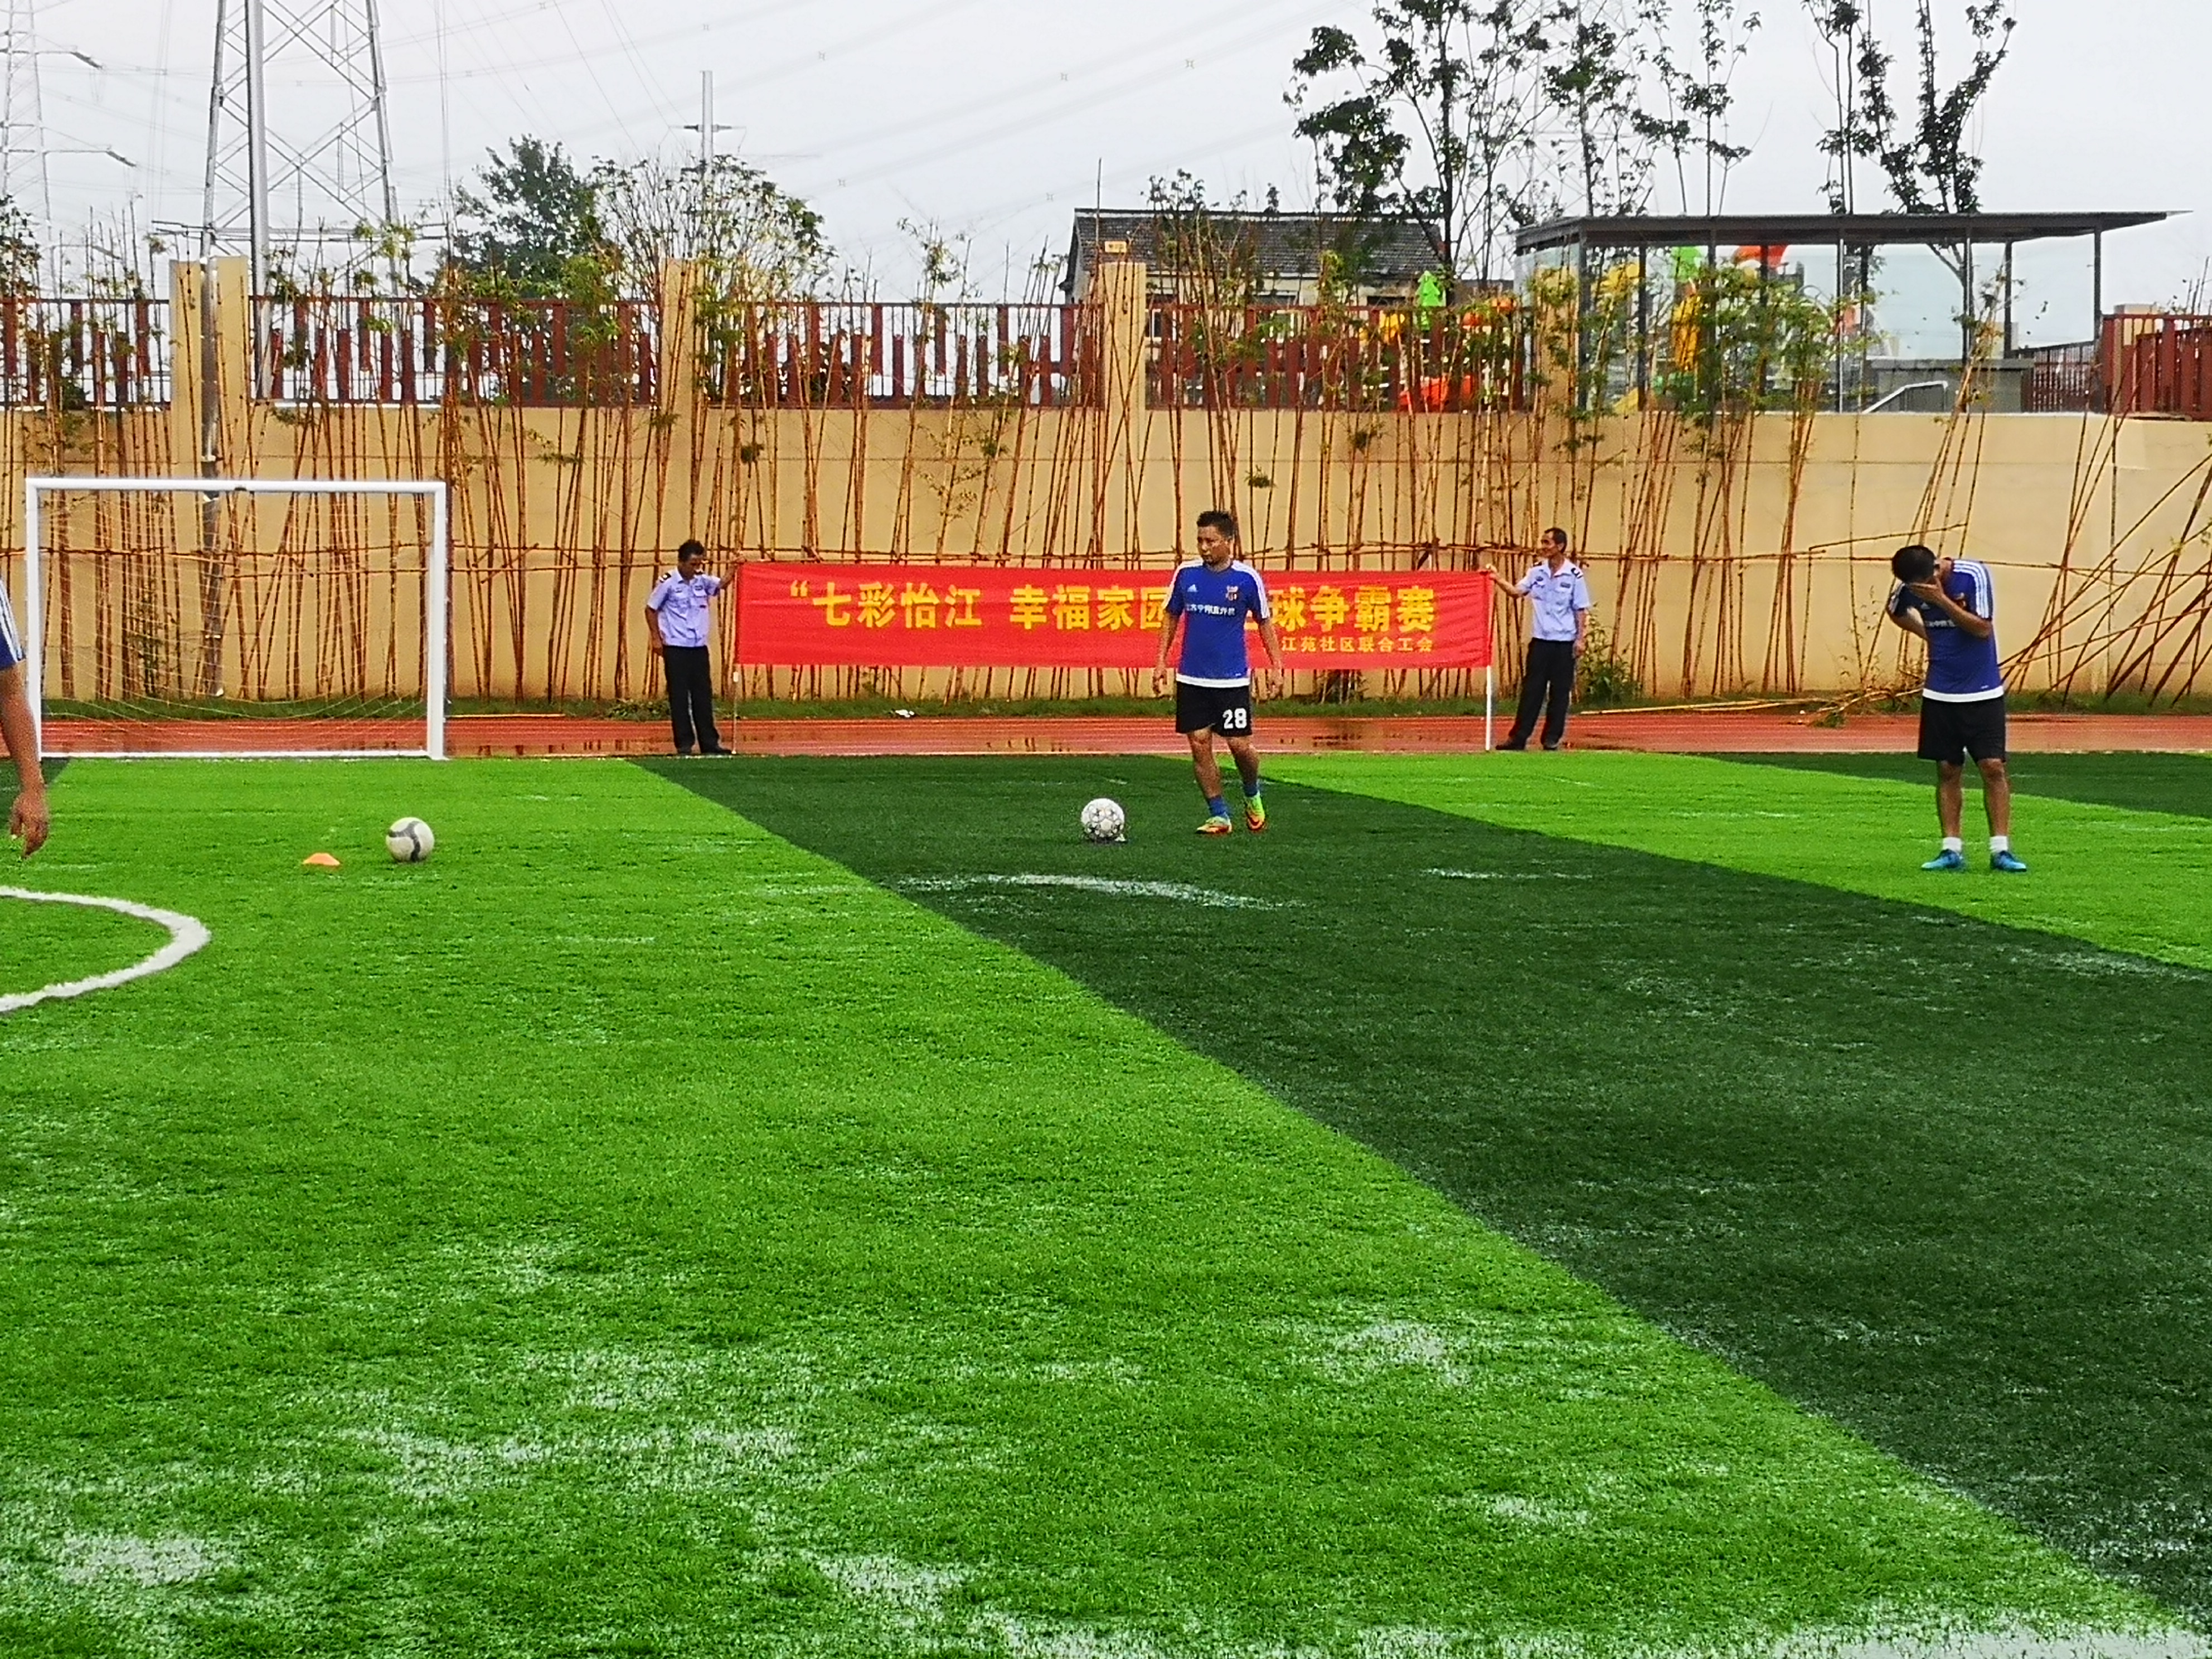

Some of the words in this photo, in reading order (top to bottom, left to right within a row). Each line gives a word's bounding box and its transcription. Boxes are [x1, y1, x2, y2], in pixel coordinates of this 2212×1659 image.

[1244, 585, 1434, 632] 球争霸赛
[1281, 636, 1433, 653] 江苑社区联合工会
[1223, 708, 1247, 729] 28
